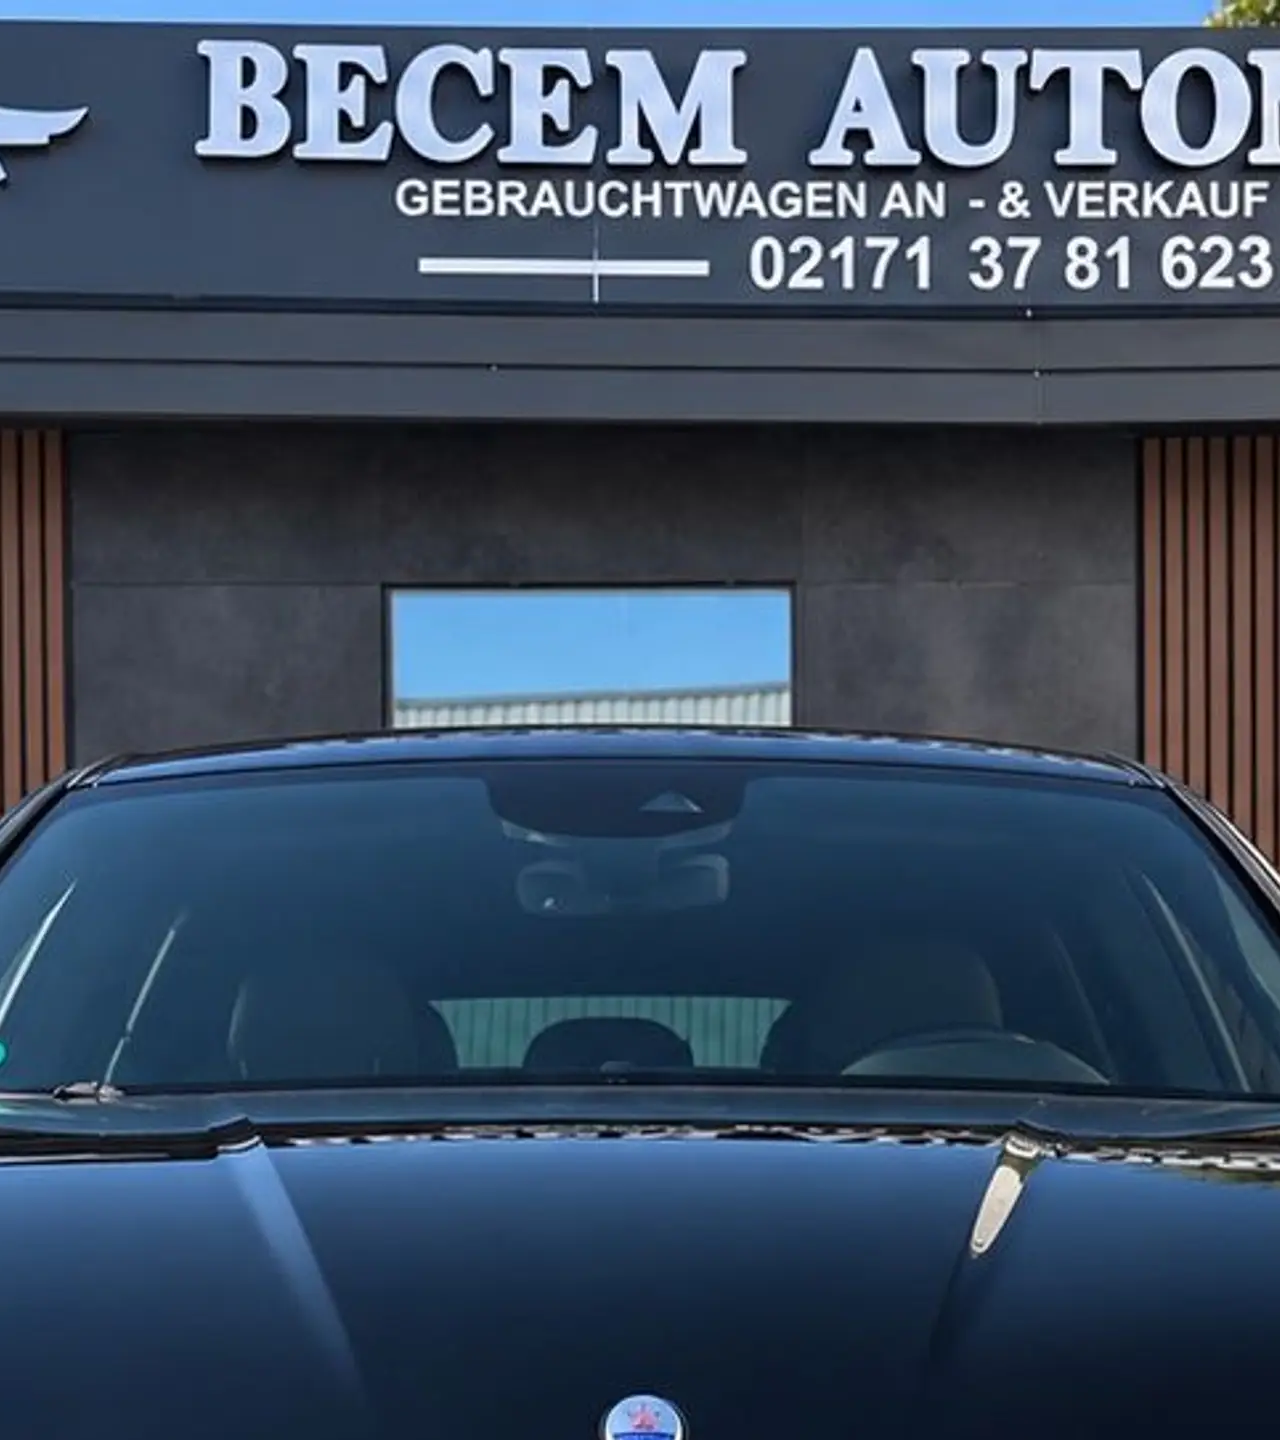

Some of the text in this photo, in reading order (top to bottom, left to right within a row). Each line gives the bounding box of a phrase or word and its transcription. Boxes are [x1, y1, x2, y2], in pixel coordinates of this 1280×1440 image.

[195, 38, 748, 166] BECEM
[395, 178, 867, 219] GEBRAUCHTWAGEN
[879, 180, 946, 219] AN
[1043, 180, 1270, 219] VERKAUF
[749, 234, 1274, 290] 02171 37 81 623
